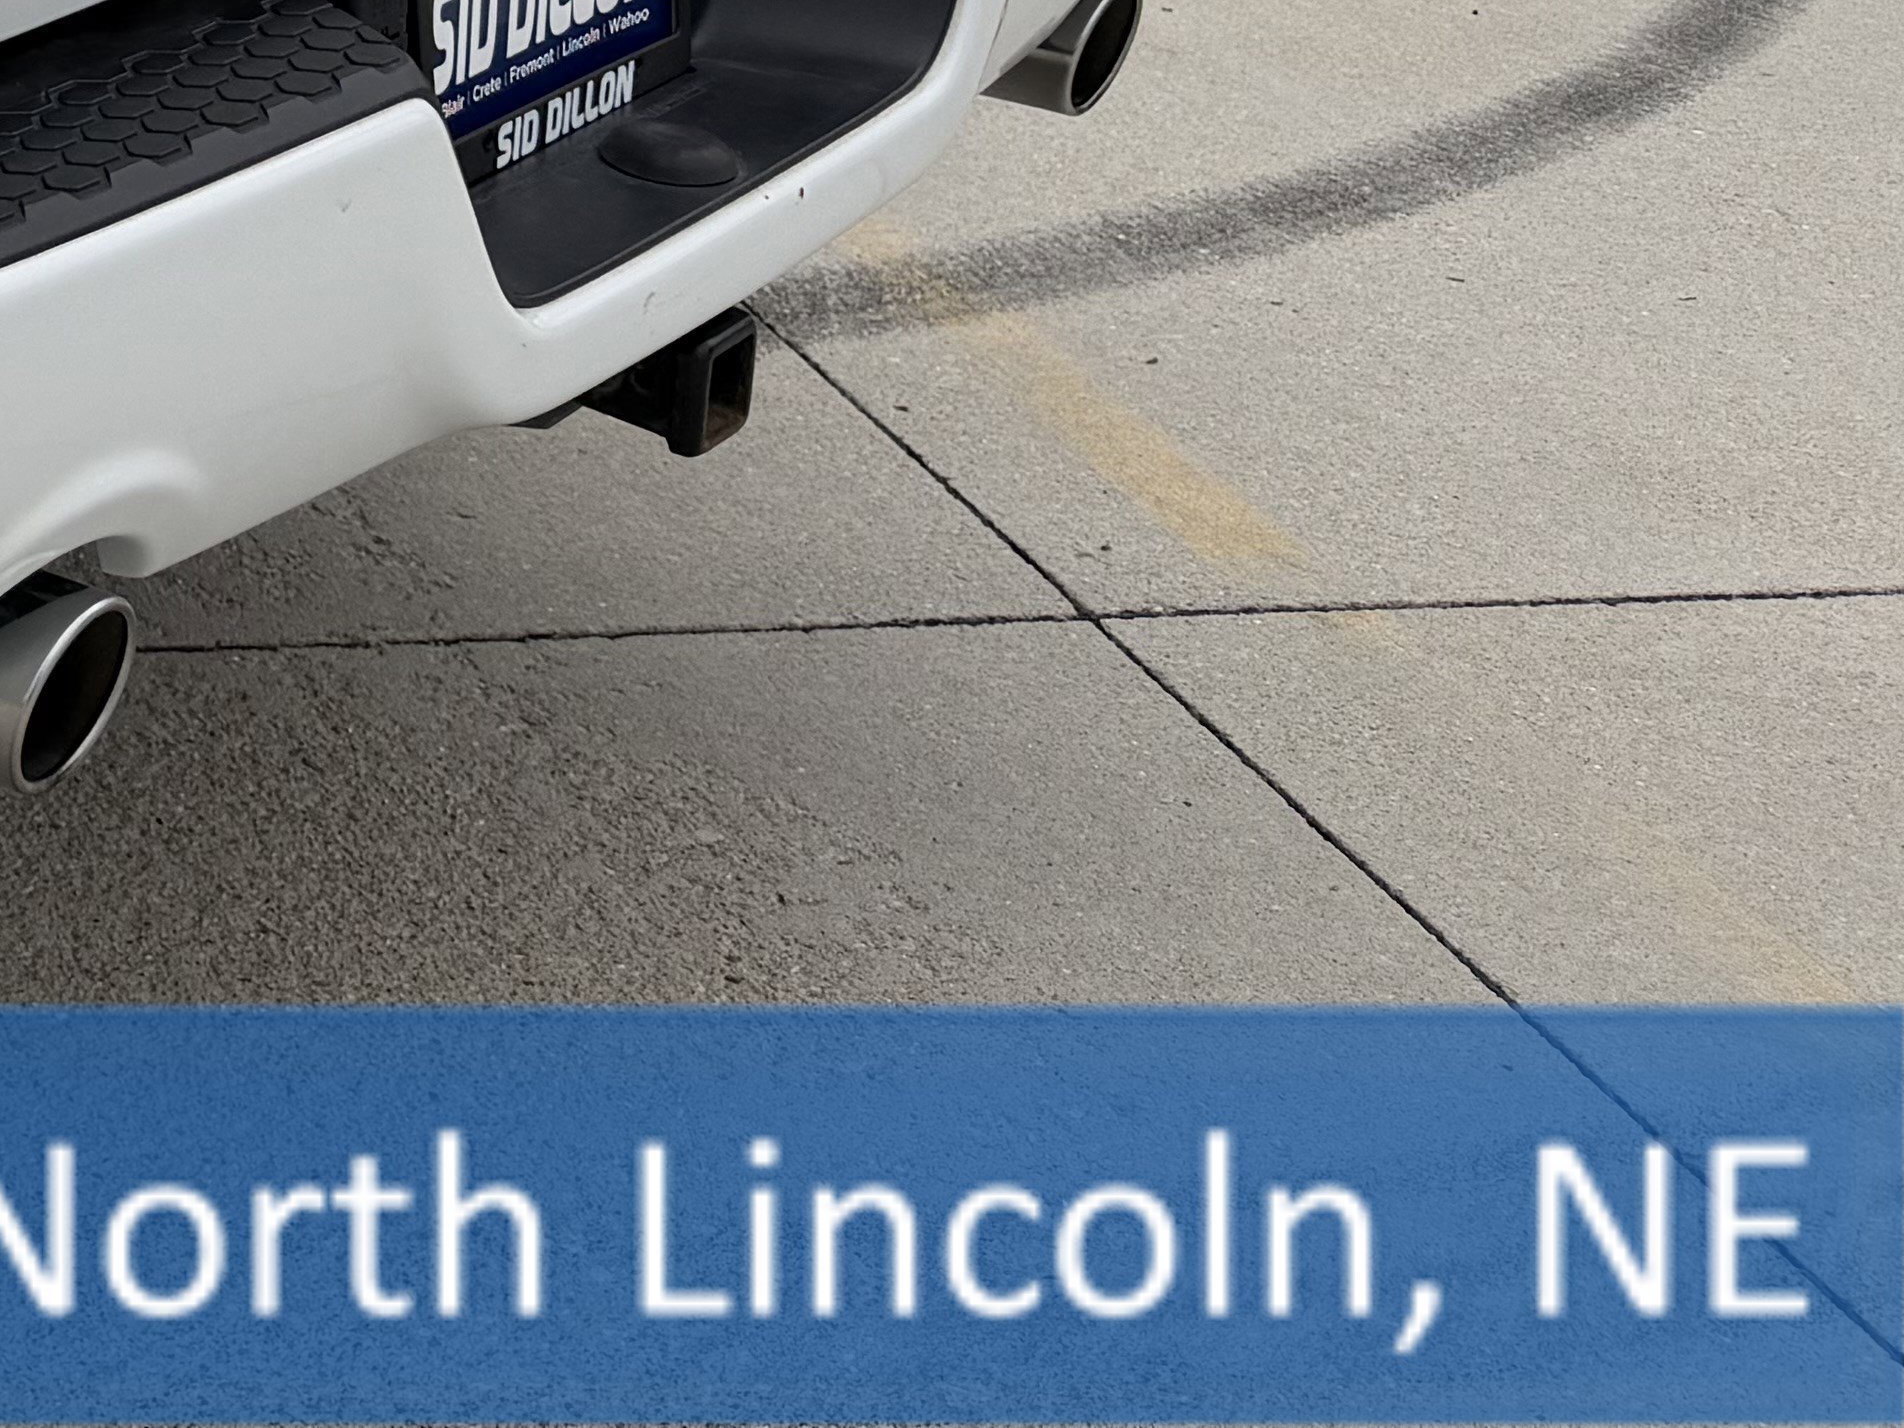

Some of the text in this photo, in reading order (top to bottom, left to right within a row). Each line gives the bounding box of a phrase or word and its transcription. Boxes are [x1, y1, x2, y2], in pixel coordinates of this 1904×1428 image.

[473, 77, 502, 102] Crete
[510, 48, 555, 84] Fremont
[562, 27, 600, 57] Lincoln
[608, 8, 650, 35] Wahoo
[496, 60, 635, 169] SID DILLON
